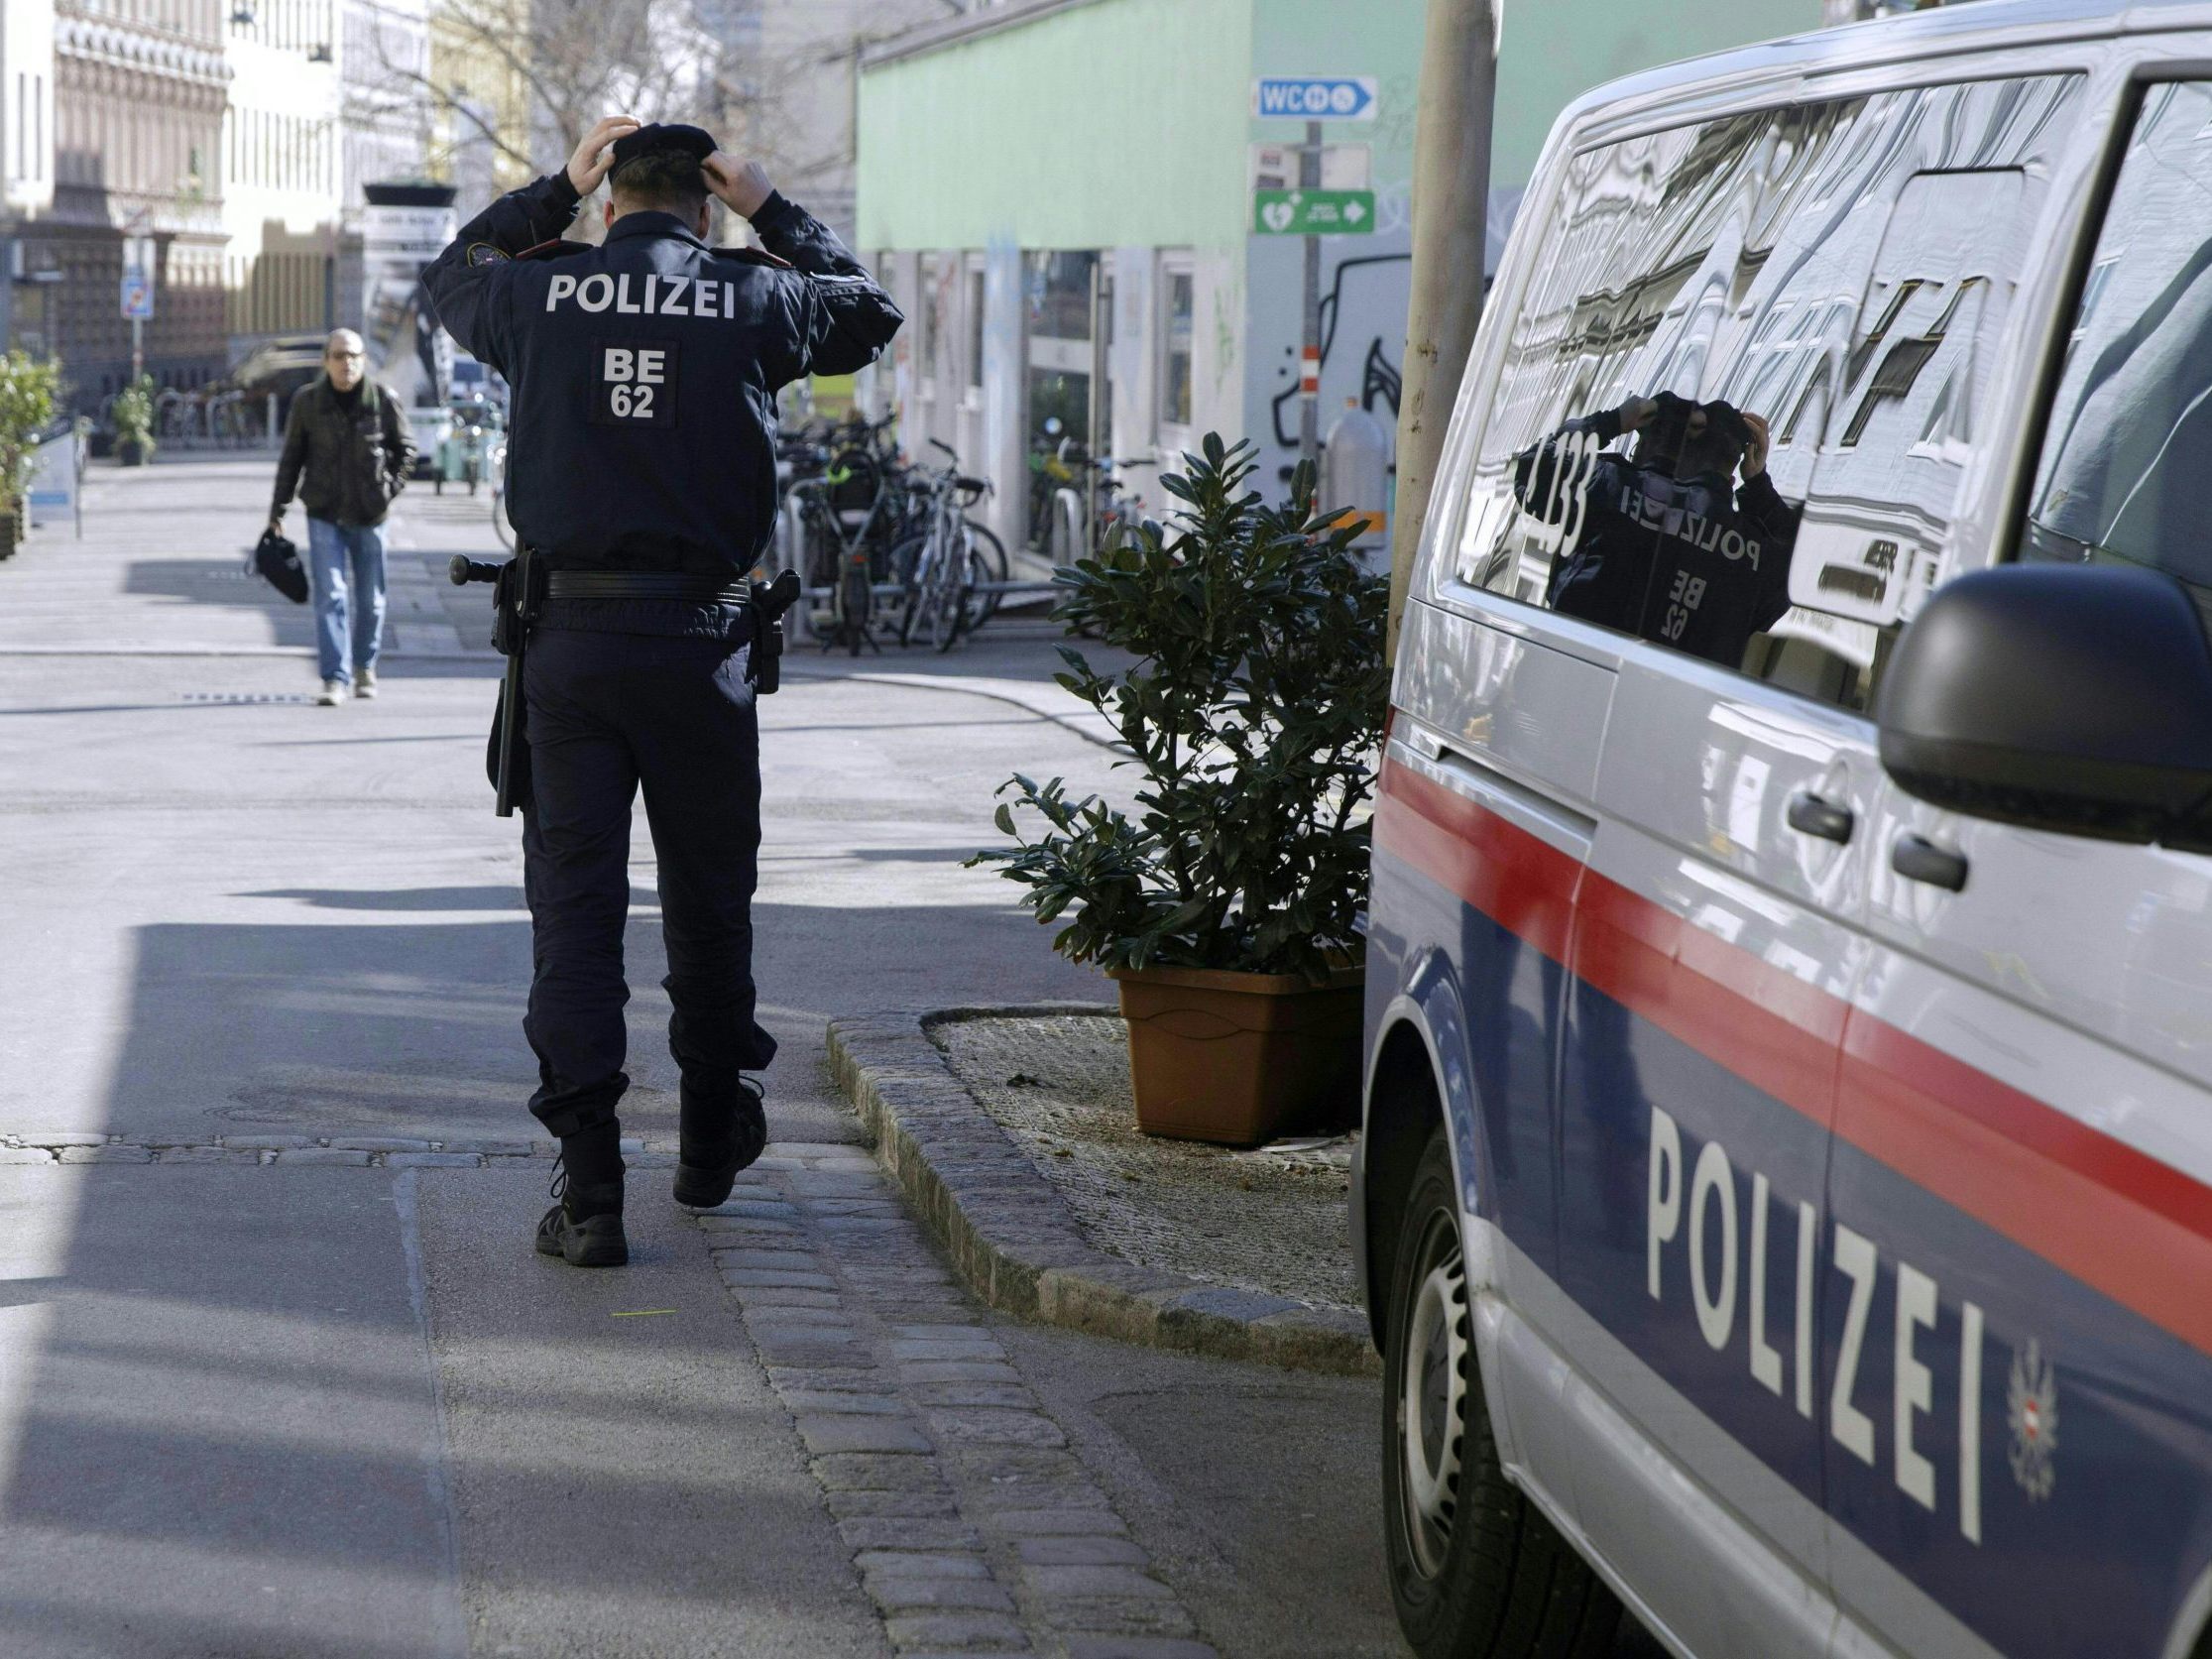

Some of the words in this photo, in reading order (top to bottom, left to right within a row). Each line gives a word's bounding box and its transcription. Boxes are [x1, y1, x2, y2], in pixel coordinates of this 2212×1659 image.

[1262, 84, 1303, 112] WC
[546, 274, 734, 319] POLIZEI
[604, 348, 665, 384] BE
[611, 384, 654, 418] 62
[1648, 1104, 1984, 1546] POLIZEI
